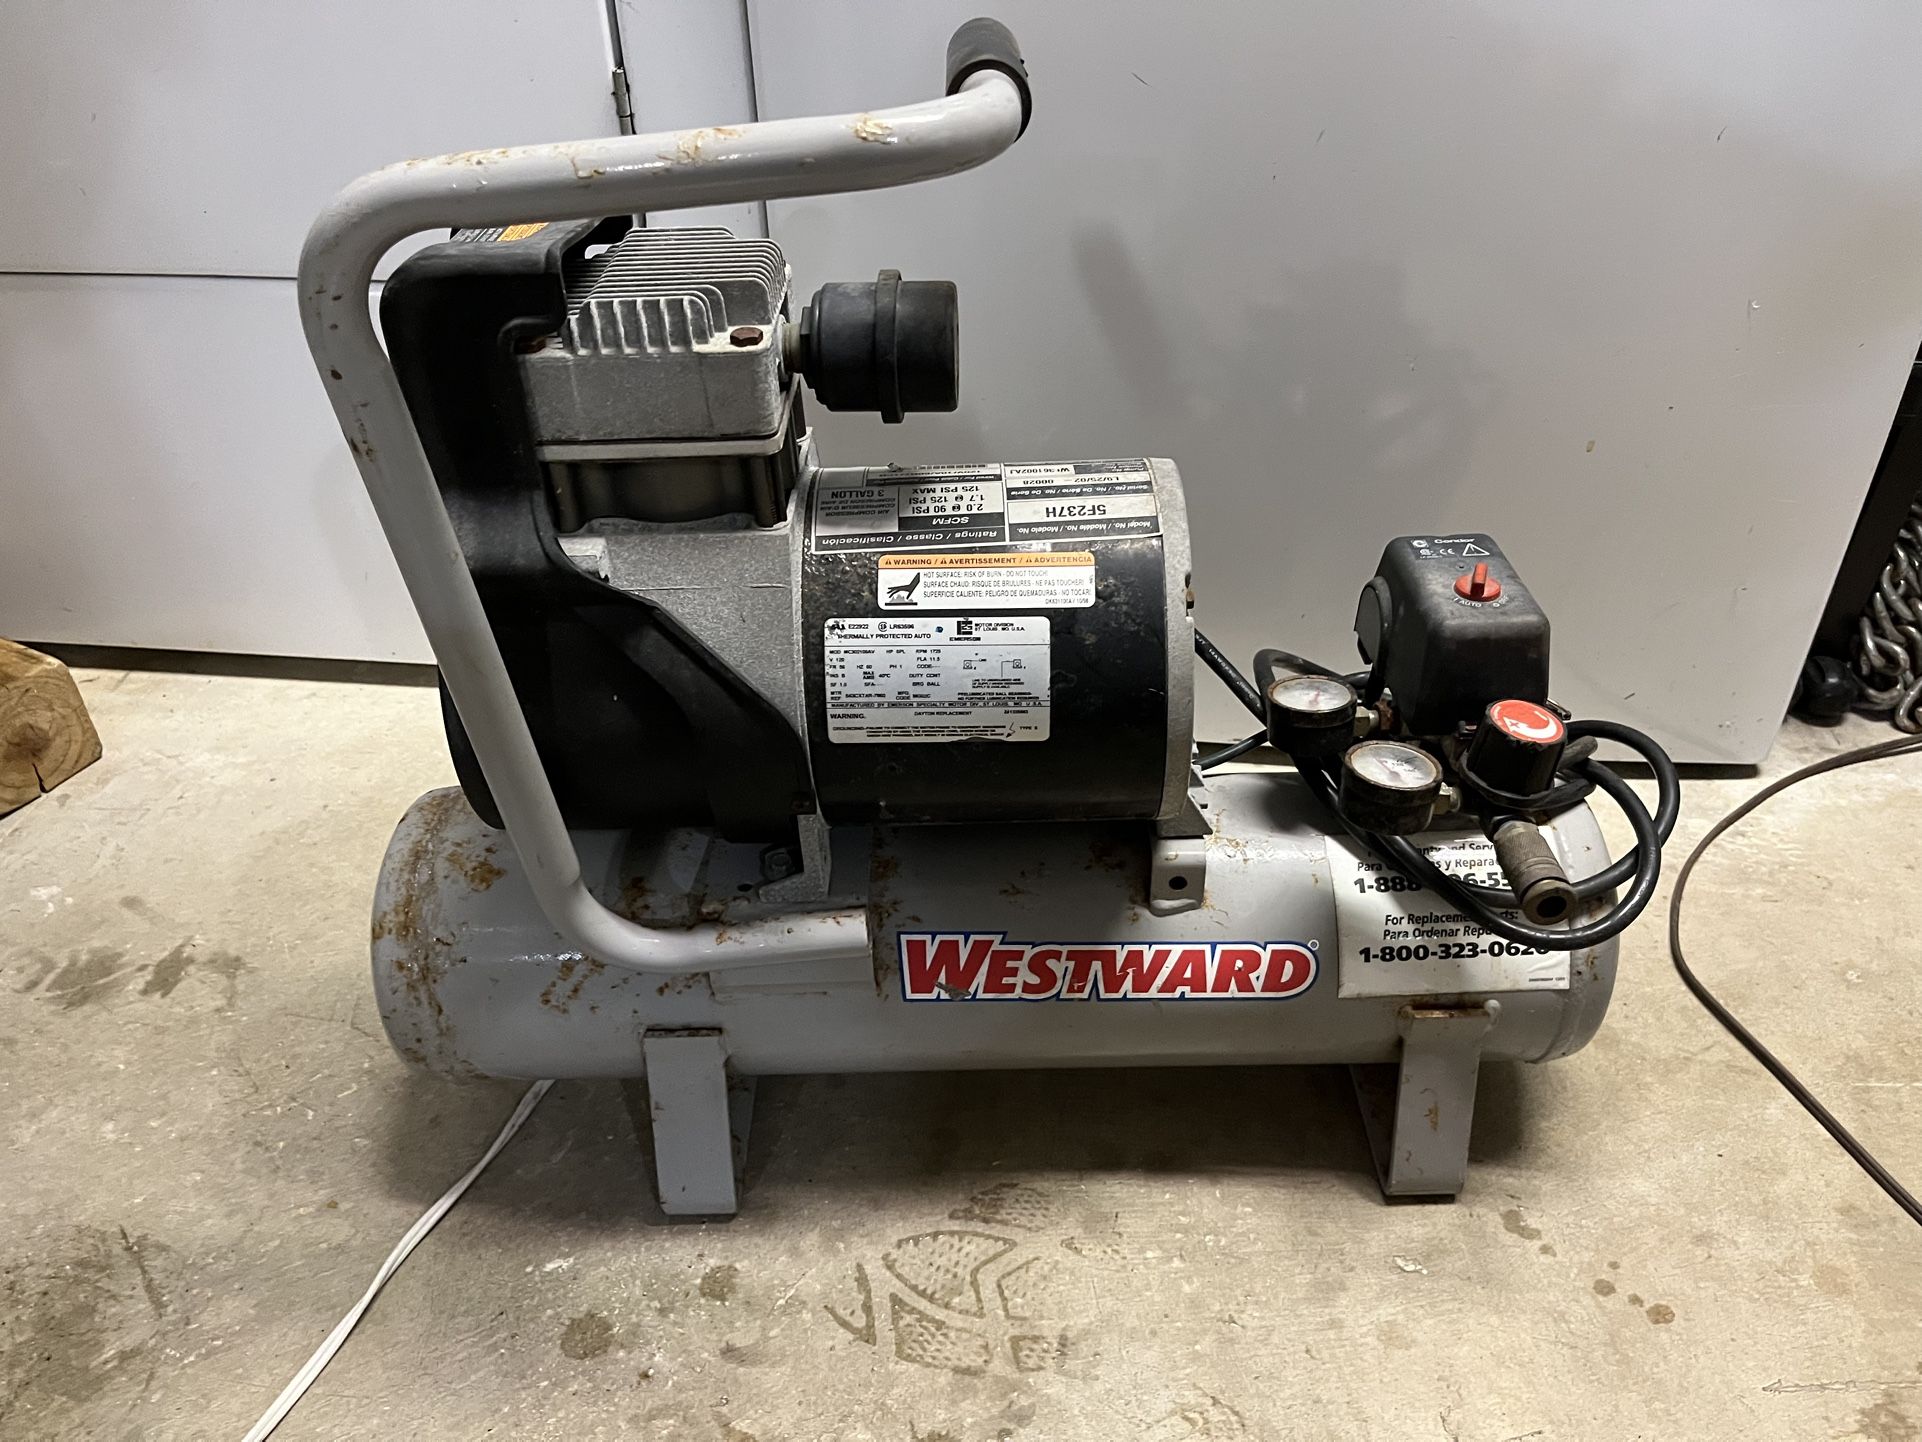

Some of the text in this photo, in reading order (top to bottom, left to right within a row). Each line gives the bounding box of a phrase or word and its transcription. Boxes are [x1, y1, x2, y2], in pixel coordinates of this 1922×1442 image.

[831, 489, 884, 499] 3 GALLON
[955, 494, 964, 503] @
[969, 494, 984, 502] 1.7
[909, 497, 926, 505] PSI
[912, 503, 983, 514] 2.0 @ 90 PSI
[1046, 505, 1106, 518] 5F237H
[932, 516, 969, 524] SCFM
[1127, 521, 1150, 529] Model
[906, 533, 943, 541] Classe
[955, 530, 997, 539] Ratings
[822, 536, 894, 546] Clasificación
[949, 557, 1016, 565] AVERTISSEMENT
[1019, 589, 1057, 597] QUEMADURAS
[1357, 862, 1382, 871] Para
[1445, 860, 1451, 870] y
[1385, 913, 1404, 925] For
[1383, 928, 1409, 940] Para
[1412, 926, 1460, 939] Ordenar
[901, 932, 1318, 1001] WESTWARD
